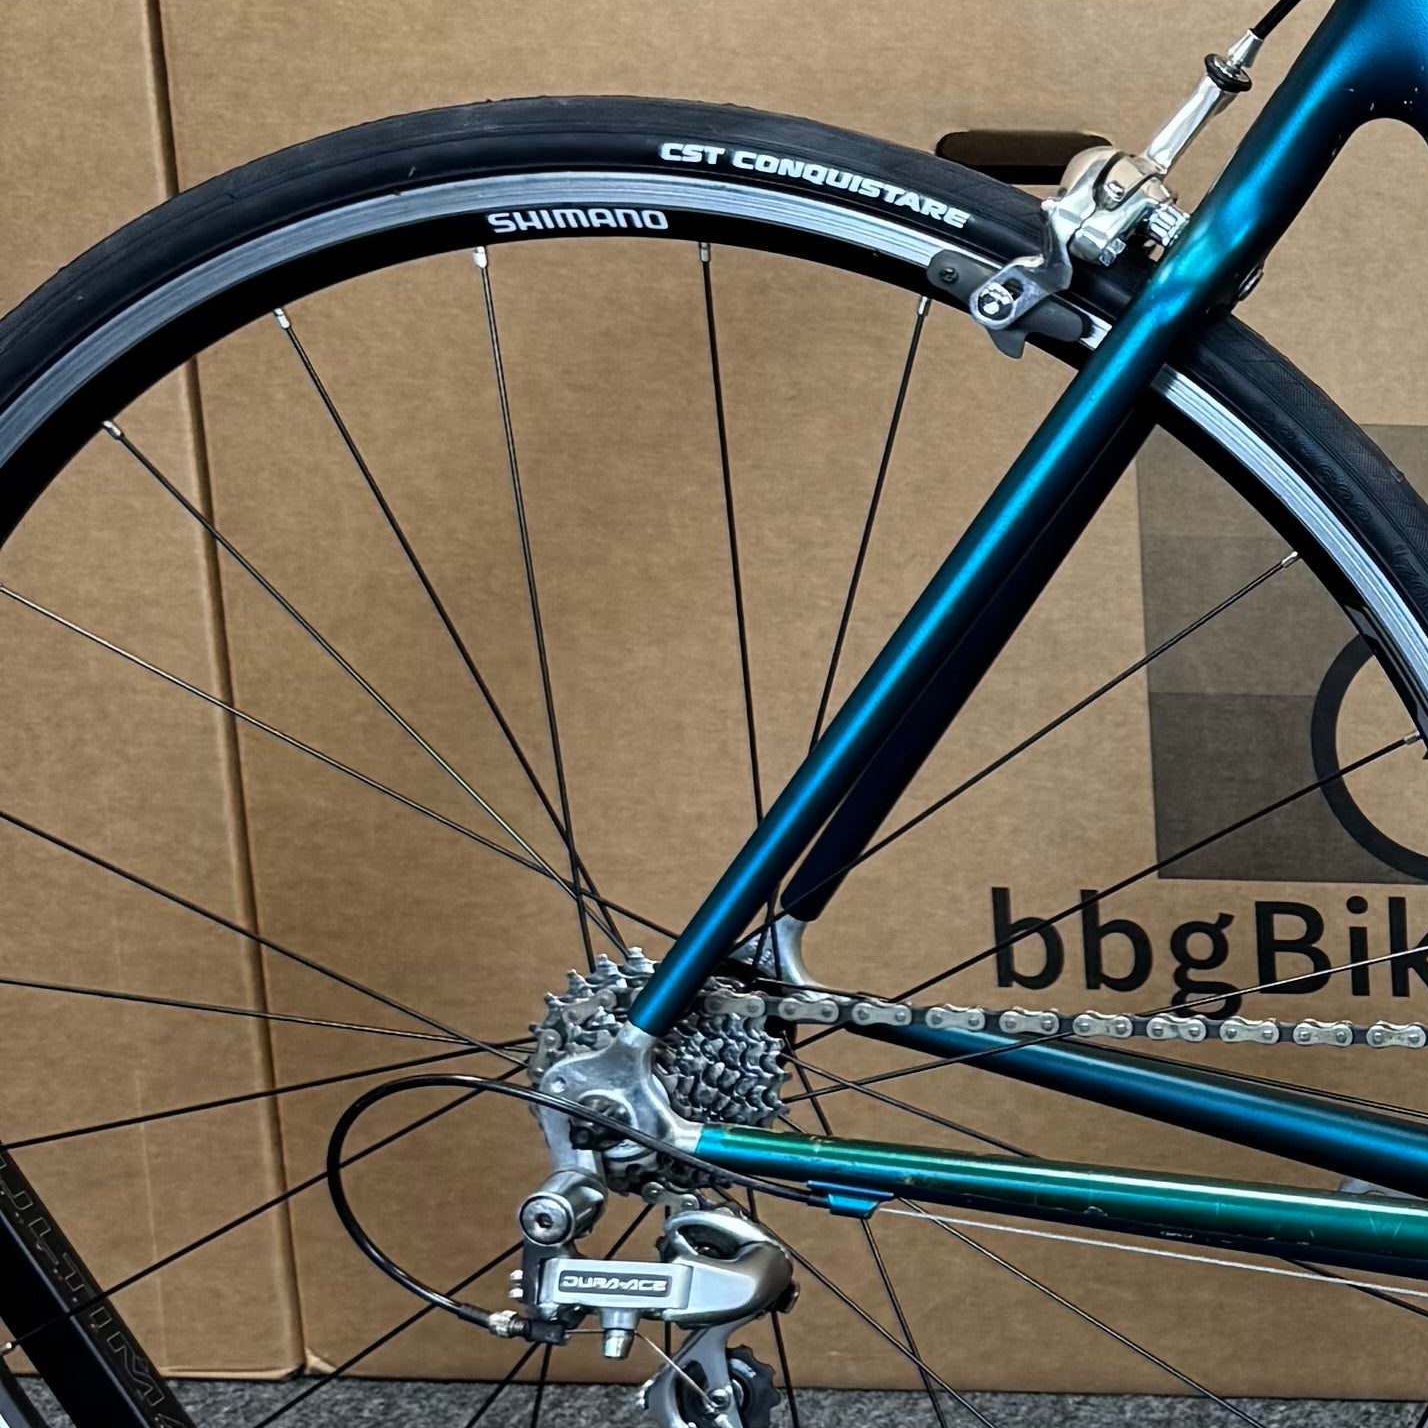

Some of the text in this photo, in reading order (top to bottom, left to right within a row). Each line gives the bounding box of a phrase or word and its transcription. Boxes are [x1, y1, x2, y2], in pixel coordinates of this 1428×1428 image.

[660, 142, 972, 230] CST CONQUISTARE
[487, 208, 669, 233] SHIMANO
[561, 1275, 669, 1293] DURA-ACE
